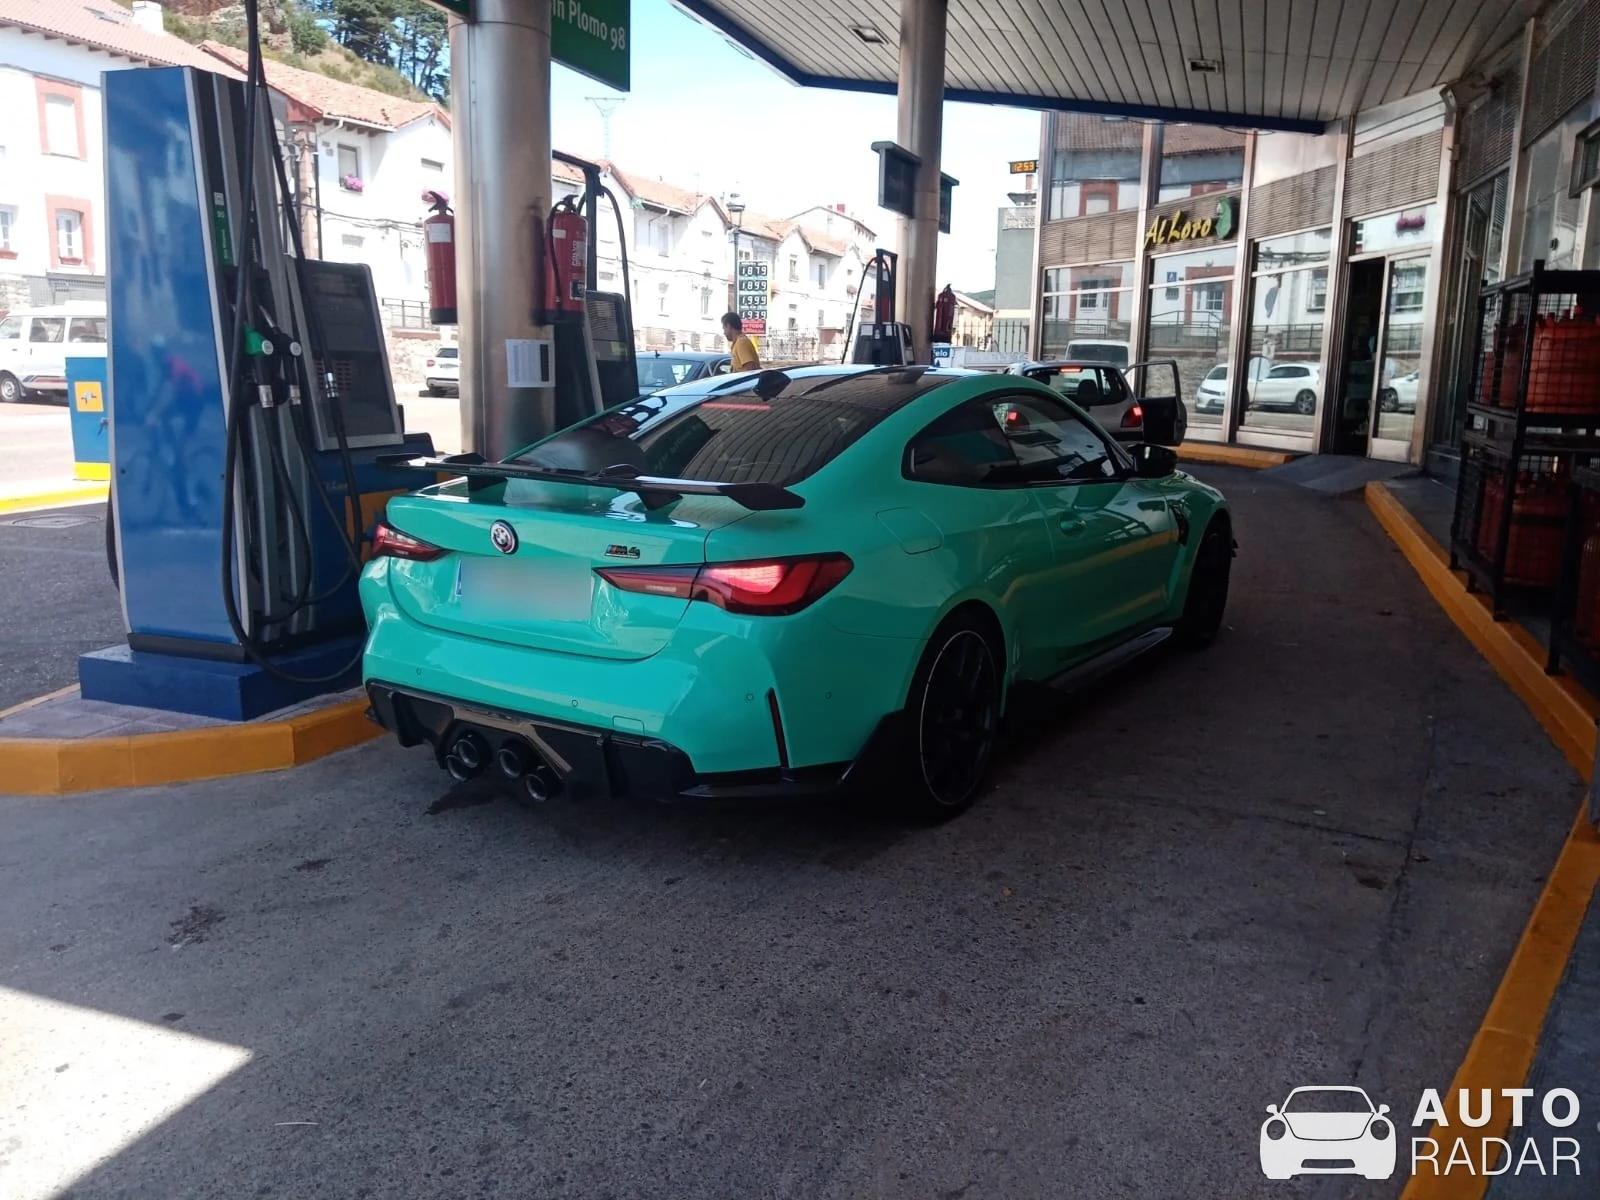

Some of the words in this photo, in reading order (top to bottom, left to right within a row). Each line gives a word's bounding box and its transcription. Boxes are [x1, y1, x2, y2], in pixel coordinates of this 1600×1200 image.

[569, 1, 607, 41] Plomo
[610, 26, 626, 50] 98
[1143, 215, 1167, 250] Al
[1168, 209, 1212, 241] Loro
